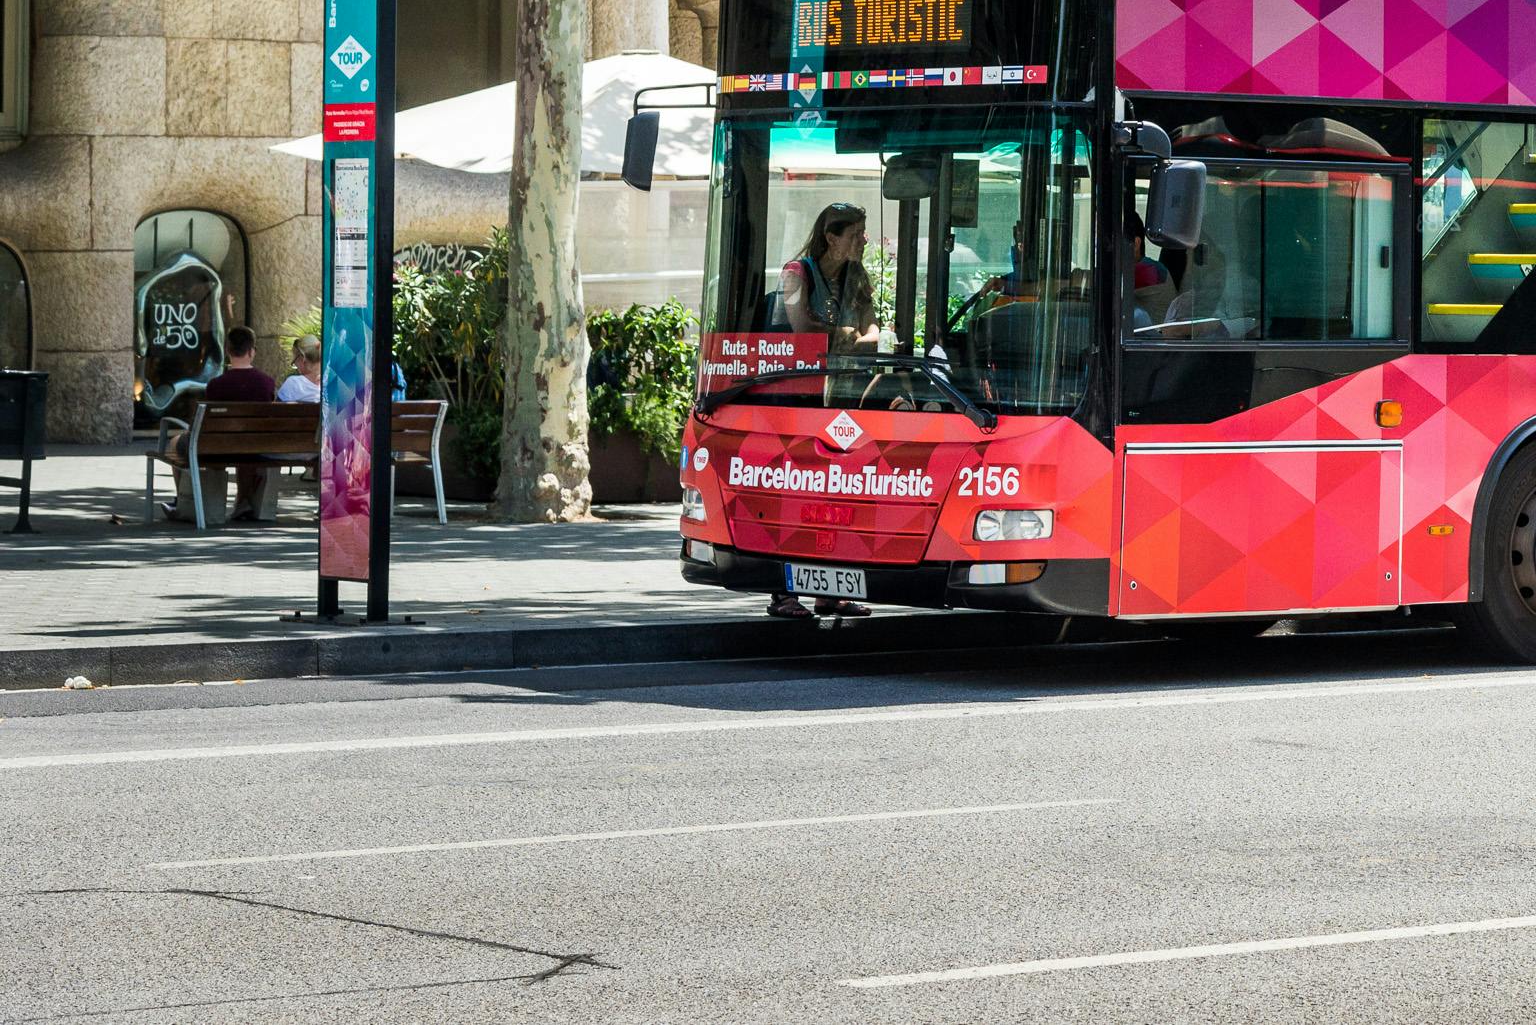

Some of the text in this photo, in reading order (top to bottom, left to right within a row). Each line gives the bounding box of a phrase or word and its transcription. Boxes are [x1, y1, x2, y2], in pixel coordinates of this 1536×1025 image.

[798, 0, 842, 47] BUS
[337, 52, 363, 65] TOUR
[154, 302, 198, 325] UNO
[153, 324, 199, 349] de 50
[722, 339, 748, 356] Ruta
[758, 339, 795, 356] Route
[703, 359, 748, 376] Vermella
[833, 425, 855, 437] TOUR
[728, 456, 933, 497] Barcelona BusTurístic
[958, 466, 1020, 497] 2156
[796, 568, 829, 592] 4755
[835, 571, 862, 595] FSY
